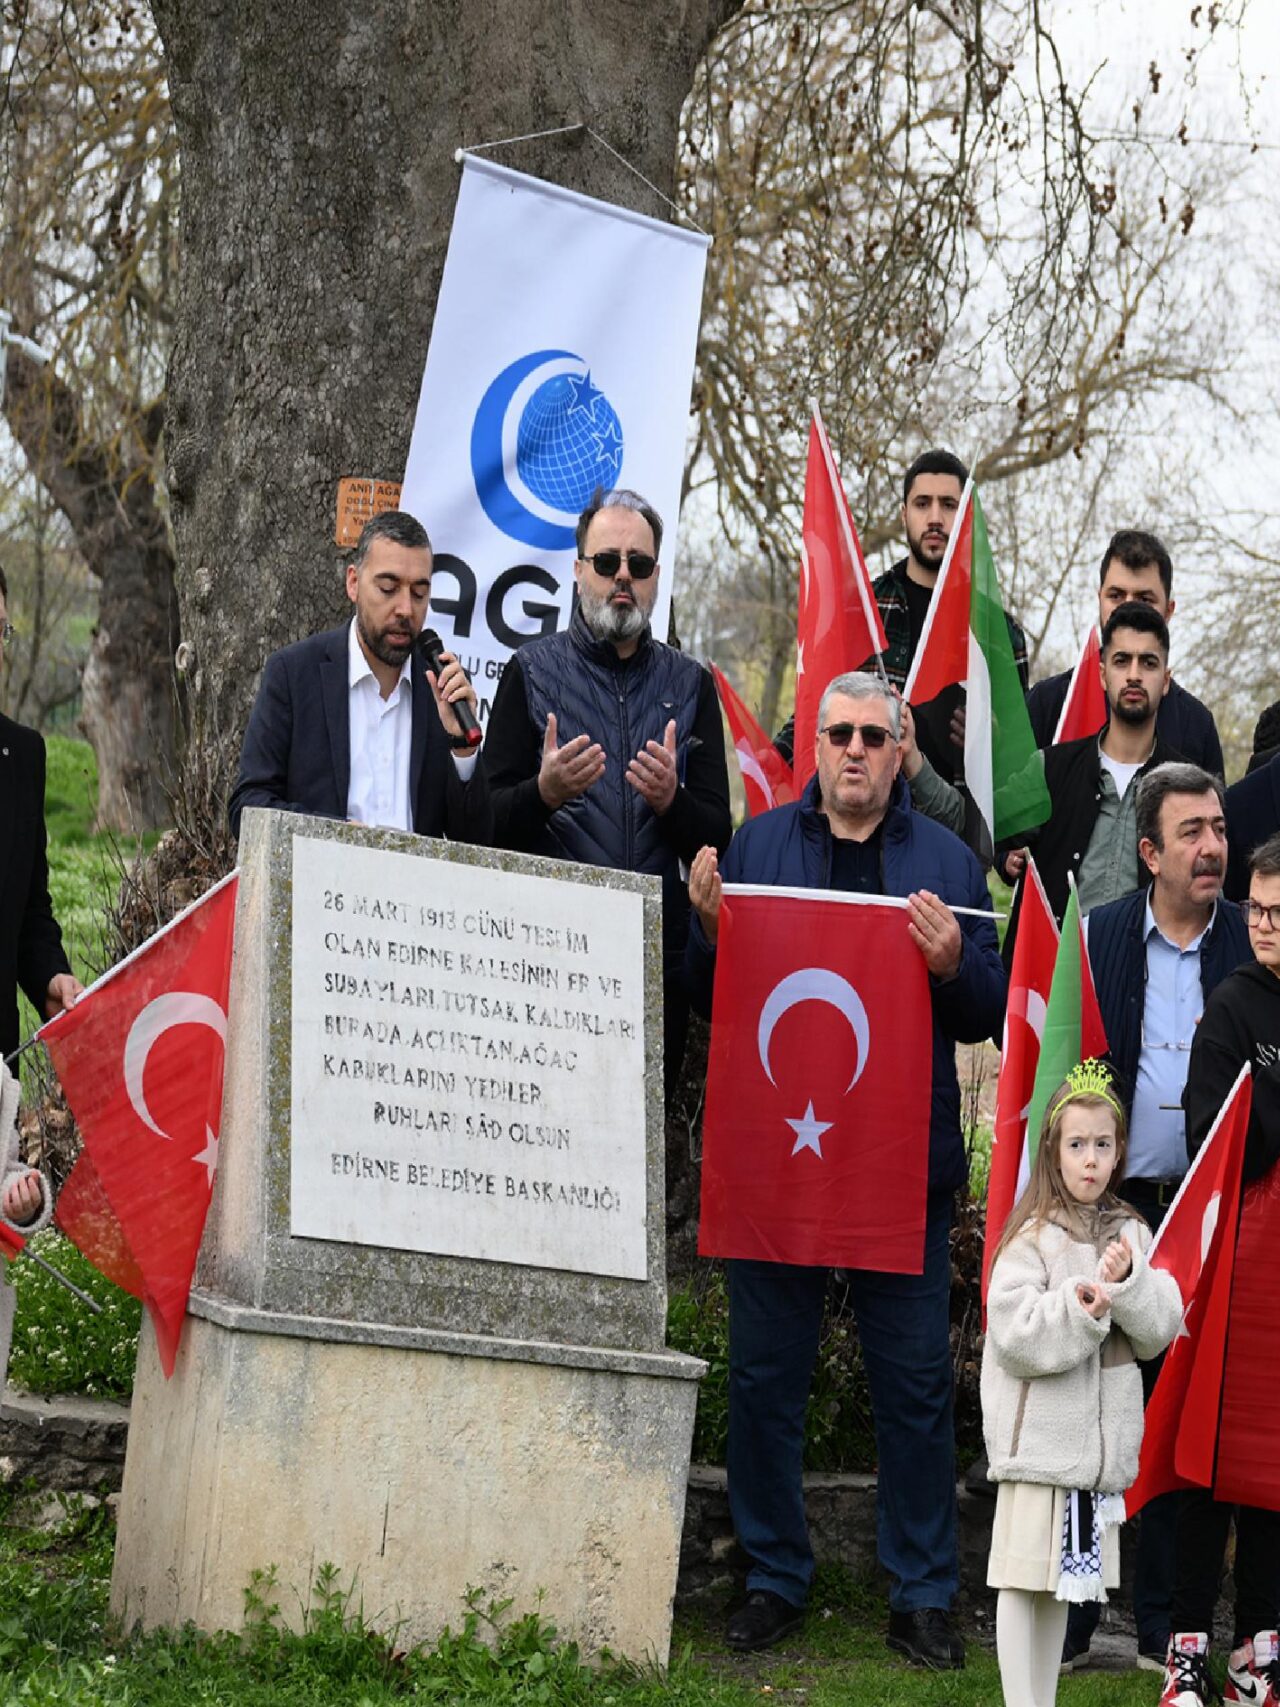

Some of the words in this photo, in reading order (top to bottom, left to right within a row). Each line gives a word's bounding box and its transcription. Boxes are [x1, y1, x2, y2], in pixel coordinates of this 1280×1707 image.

[324, 889, 344, 912] 26
[352, 894, 411, 923] MART
[420, 904, 456, 931] 1913
[325, 932, 381, 960] OLAN
[388, 941, 454, 971] EDİRNE
[568, 972, 589, 993] ER
[598, 975, 622, 999] VE
[442, 990, 518, 1024] TUTSAK
[525, 1003, 636, 1040] KALDIKLARI
[323, 1054, 455, 1094] KABUKLARINI
[374, 1101, 457, 1133] RUHLARI
[509, 1122, 570, 1150] OLSUN
[331, 1152, 400, 1183] EDİRNE
[407, 1164, 497, 1195] BELEDİYE
